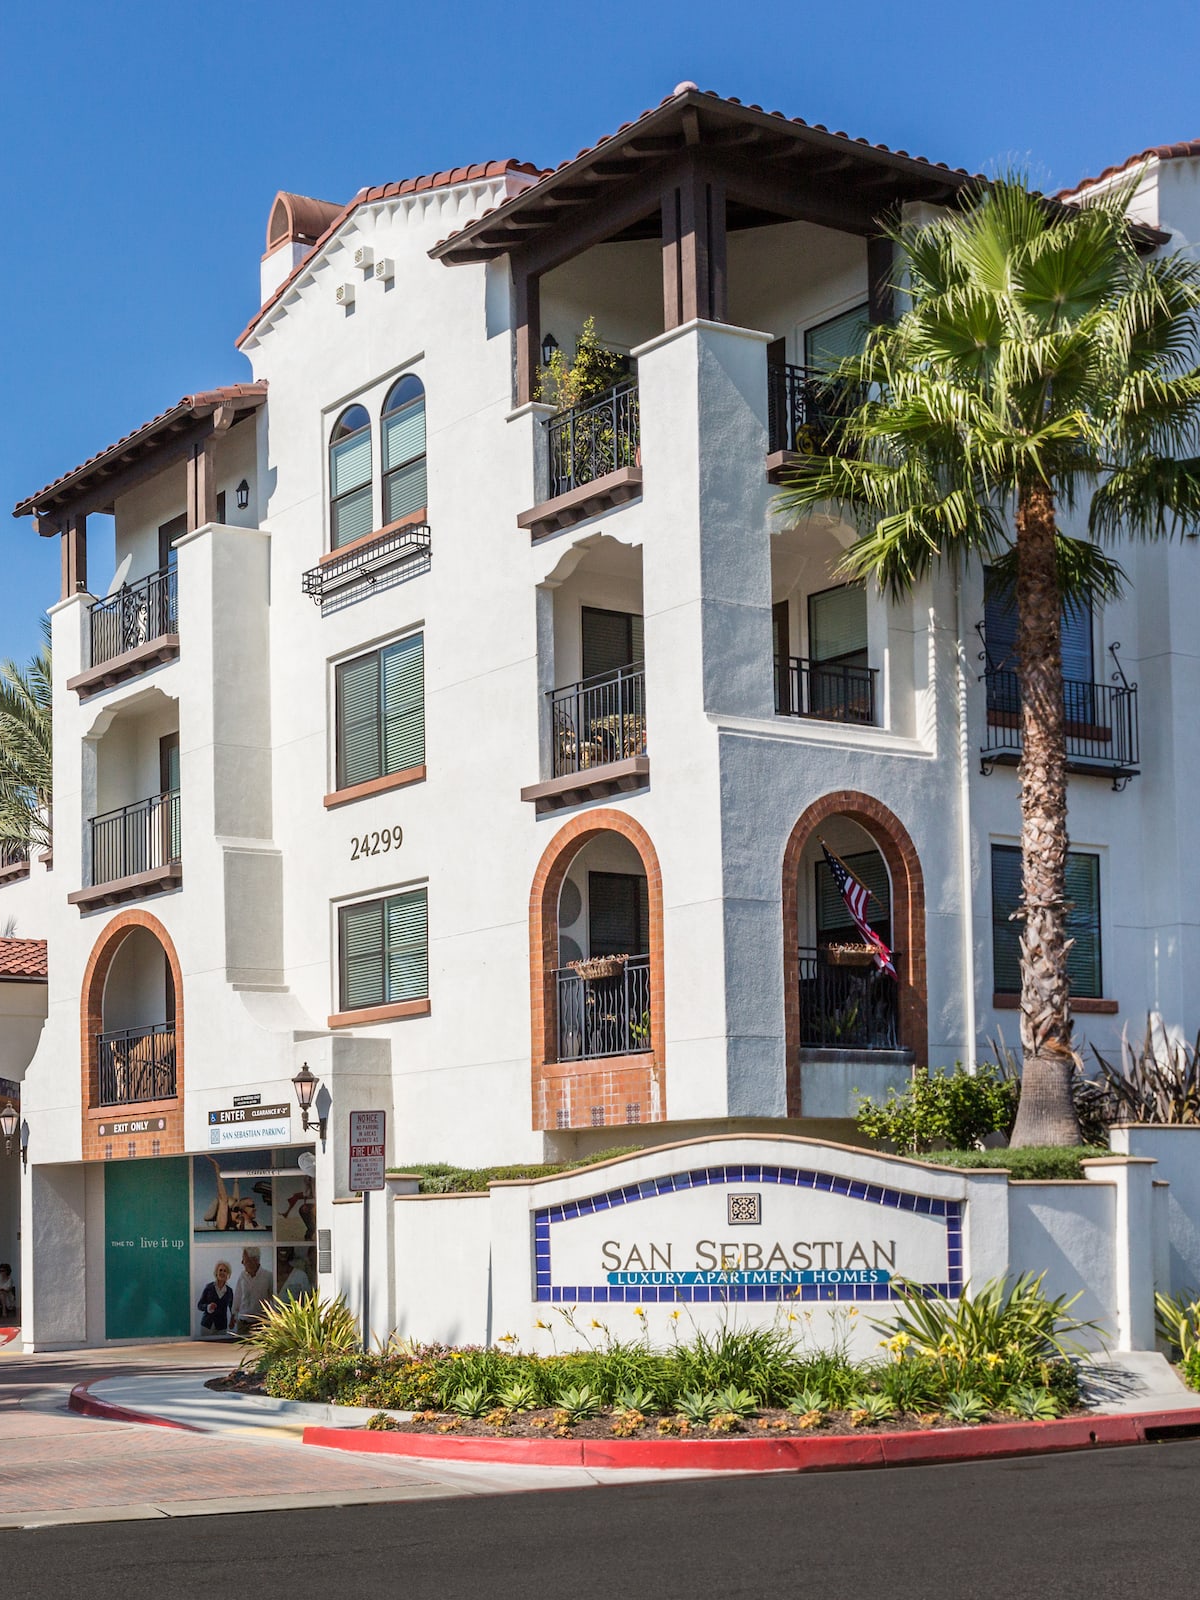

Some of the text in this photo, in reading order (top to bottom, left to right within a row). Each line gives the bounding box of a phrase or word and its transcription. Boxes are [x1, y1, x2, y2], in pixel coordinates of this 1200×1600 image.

[350, 825, 403, 861] 24299
[220, 1110, 245, 1122] ENTER
[251, 1108, 277, 1117] CLEARANCE
[357, 1114, 378, 1123] NOTICE
[113, 1120, 149, 1133] EXIT ONLY
[222, 1126, 286, 1140] SAN SEBASTIAN PARKING
[352, 1145, 383, 1156] FIRE LANE
[140, 1237, 158, 1248] live
[161, 1237, 168, 1248] it
[171, 1239, 184, 1250] up
[601, 1239, 897, 1272] SAN SEBASTIAN
[617, 1270, 879, 1285] LUXURY APARTMENT HOMES
